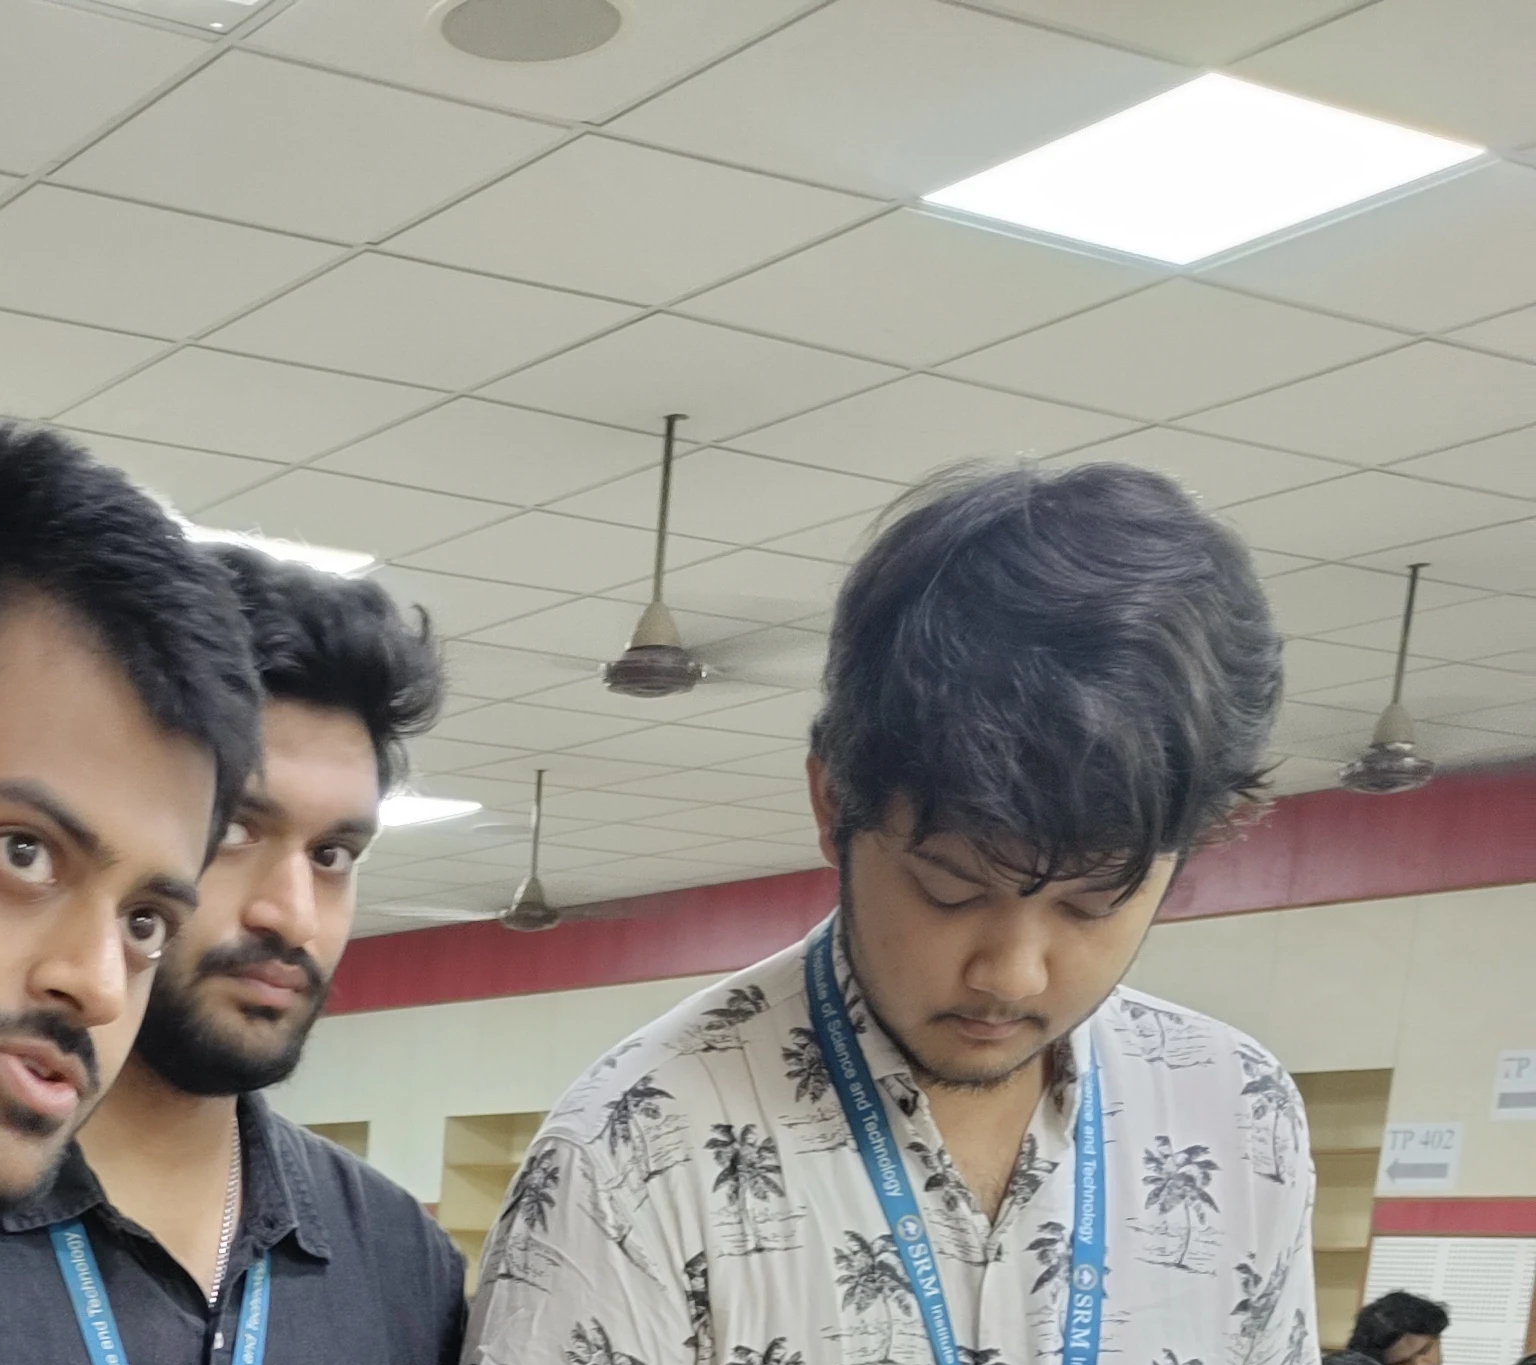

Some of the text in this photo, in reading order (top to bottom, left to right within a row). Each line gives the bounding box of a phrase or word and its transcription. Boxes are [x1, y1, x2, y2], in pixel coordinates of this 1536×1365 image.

[821, 1001, 838, 1018] of
[827, 1016, 857, 1079] Science
[849, 1082, 871, 1111] and
[862, 1110, 905, 1198] Technology
[1084, 1126, 1097, 1155] and
[1388, 1129, 1455, 1150] TP 402
[1077, 1159, 1097, 1245] Technology
[64, 1232, 104, 1318] Technology
[908, 1243, 941, 1298] SRM
[930, 1303, 954, 1365] Institute
[92, 1320, 114, 1350] and
[1069, 1292, 1093, 1350] SRM
